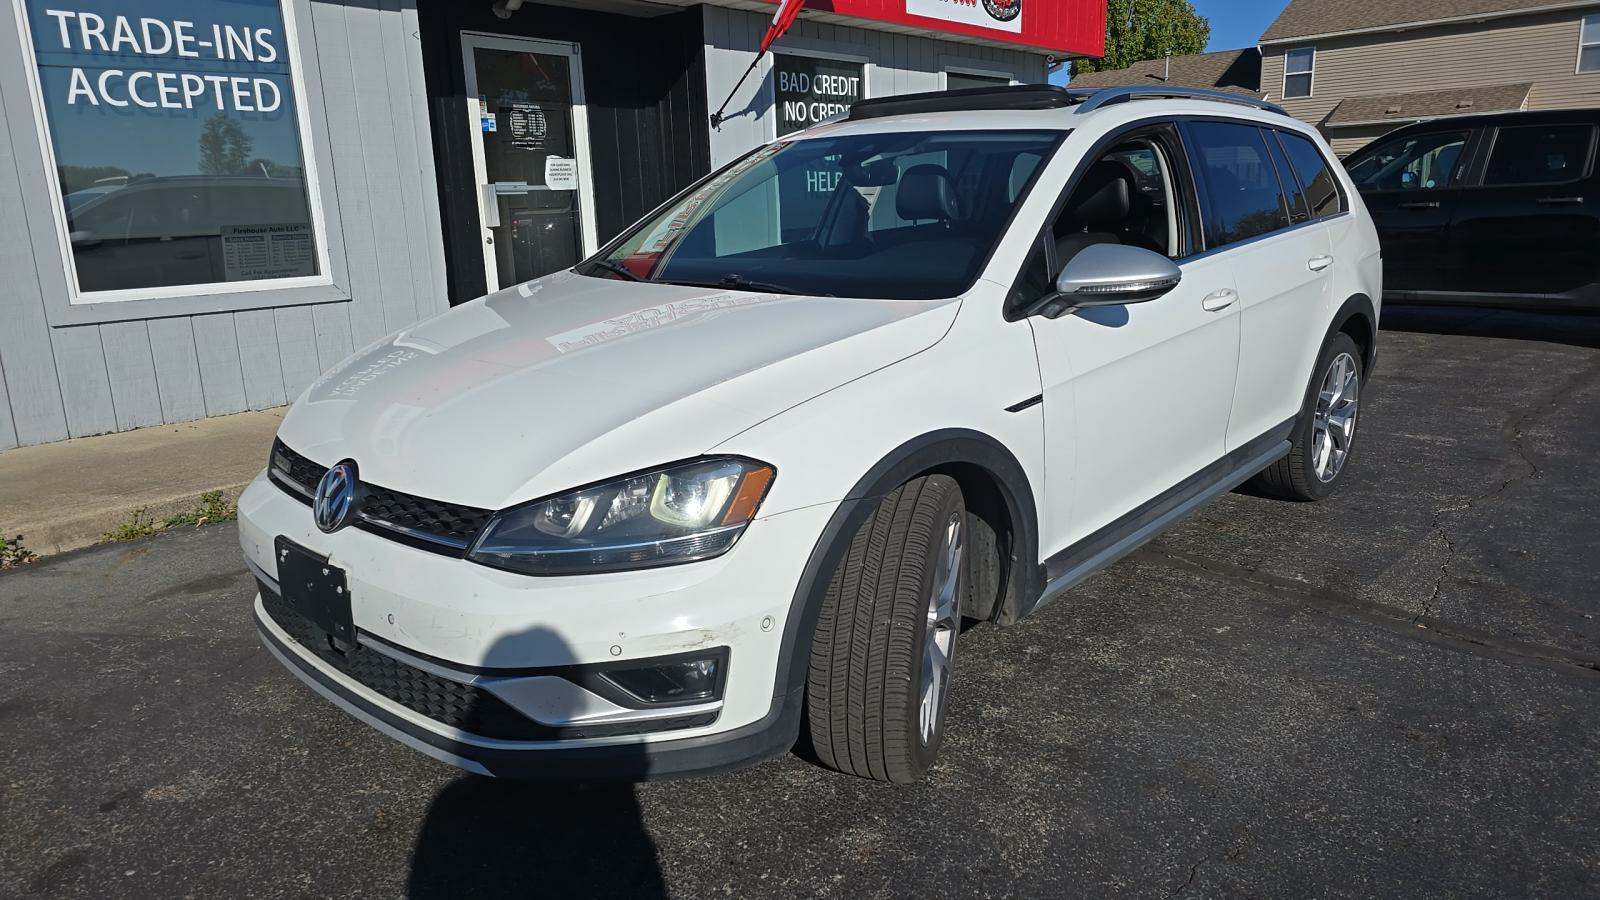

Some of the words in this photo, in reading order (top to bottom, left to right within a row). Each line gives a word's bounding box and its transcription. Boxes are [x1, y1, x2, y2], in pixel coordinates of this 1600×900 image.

[46, 9, 277, 63] TRADE-INS
[67, 68, 281, 113] ACCEPTED
[780, 71, 810, 93] BAD
[813, 74, 860, 97] CREDIT
[785, 100, 807, 122] NO
